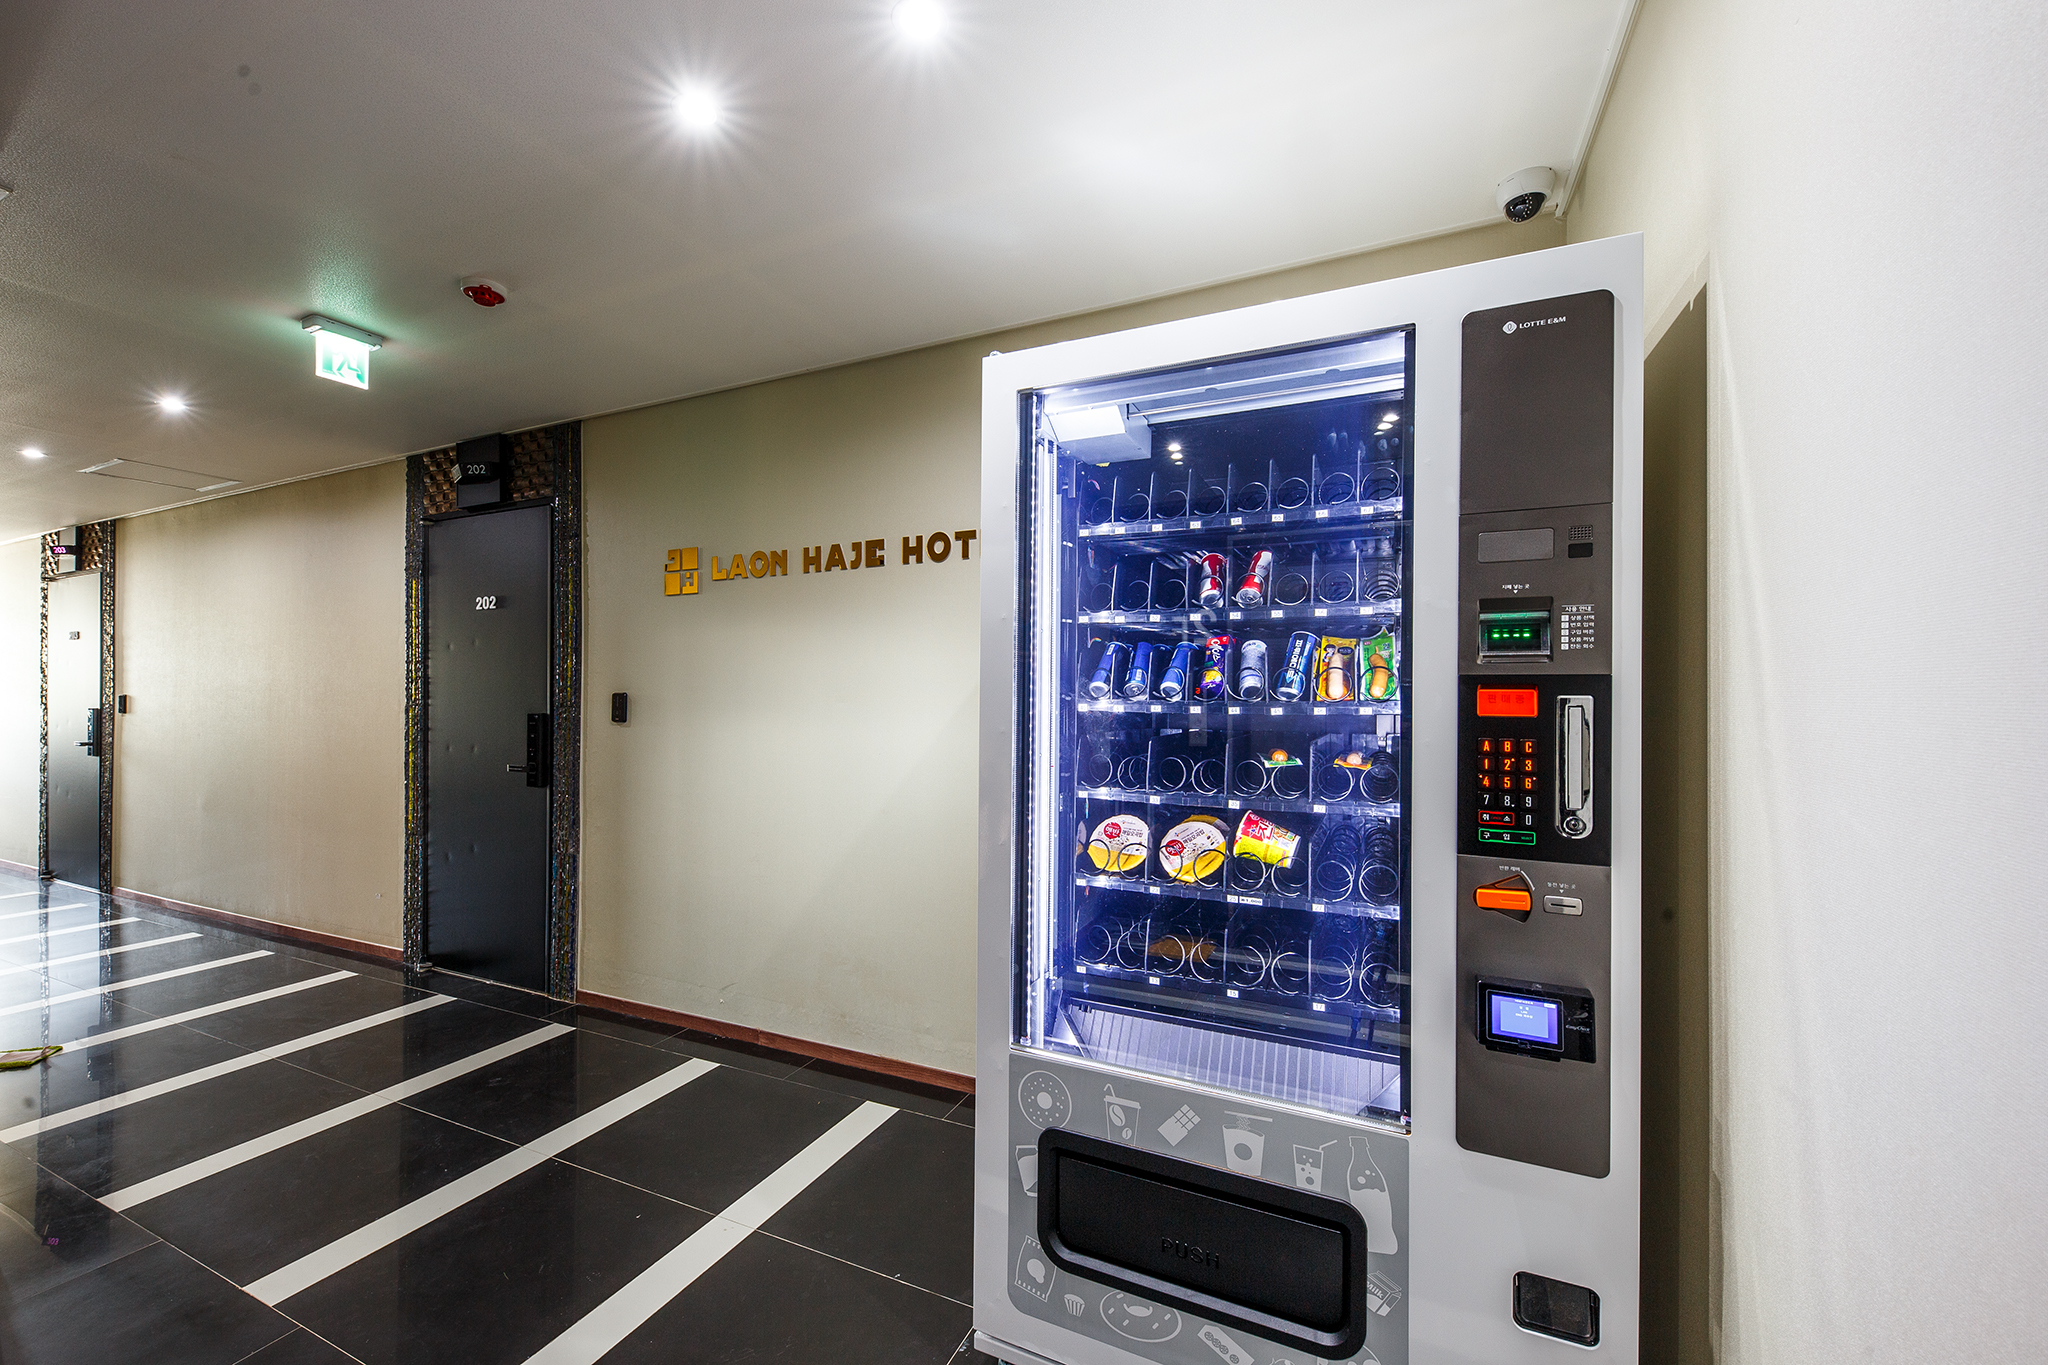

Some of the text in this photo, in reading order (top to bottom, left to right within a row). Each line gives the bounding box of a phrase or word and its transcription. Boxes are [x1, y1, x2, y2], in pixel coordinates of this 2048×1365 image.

[1519, 316, 1567, 329] LOTTE E&M
[466, 464, 487, 475] 202
[53, 546, 67, 554] 203
[711, 529, 981, 581] LAON HAJE HOT
[475, 595, 497, 611] 202
[1483, 741, 1532, 753] A B C
[1485, 758, 1532, 771] 1 2 3
[1483, 776, 1531, 789] 4 5 6
[1484, 794, 1531, 807] 7 8 9
[1525, 815, 1531, 825] 0
[1161, 1236, 1220, 1270] PUSH
